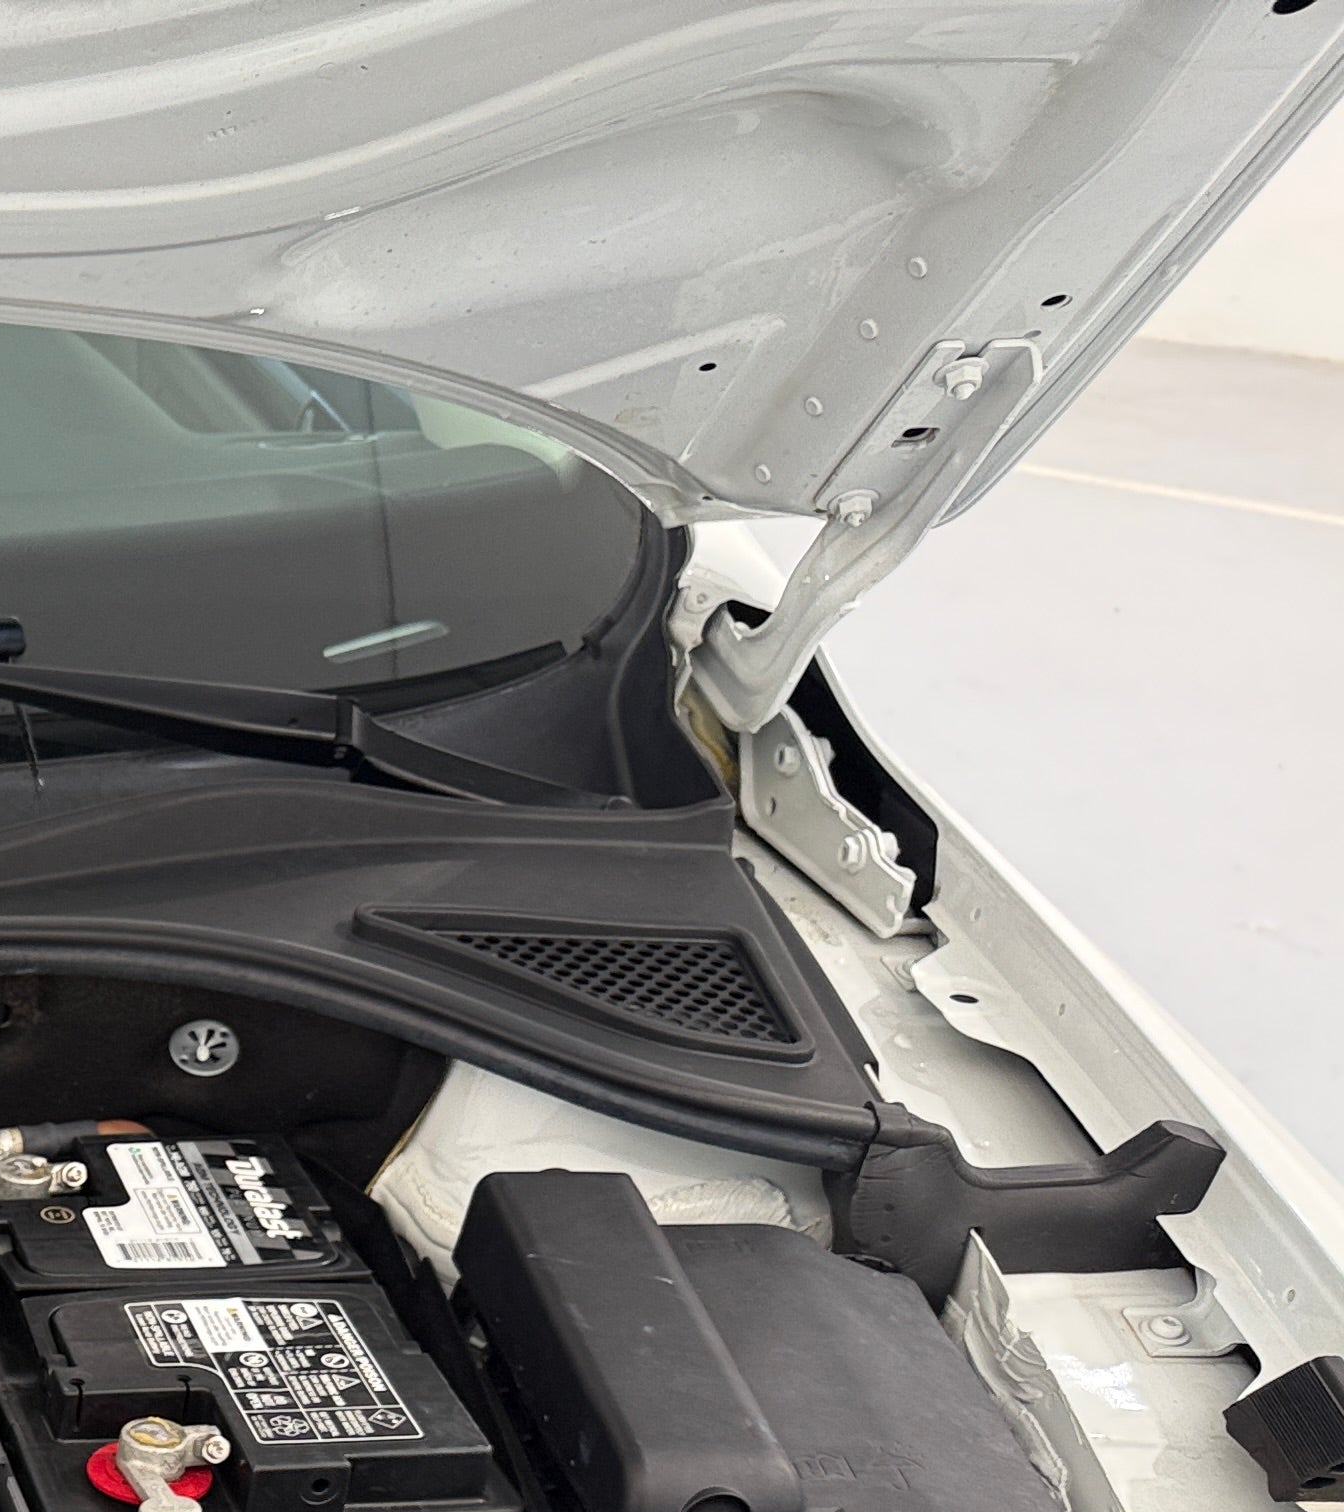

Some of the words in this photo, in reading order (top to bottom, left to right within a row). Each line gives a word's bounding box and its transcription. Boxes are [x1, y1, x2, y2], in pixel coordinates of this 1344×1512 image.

[225, 1156, 304, 1240] Duralast
[332, 1319, 359, 1358] DANGER
[355, 1355, 388, 1392] POISON
